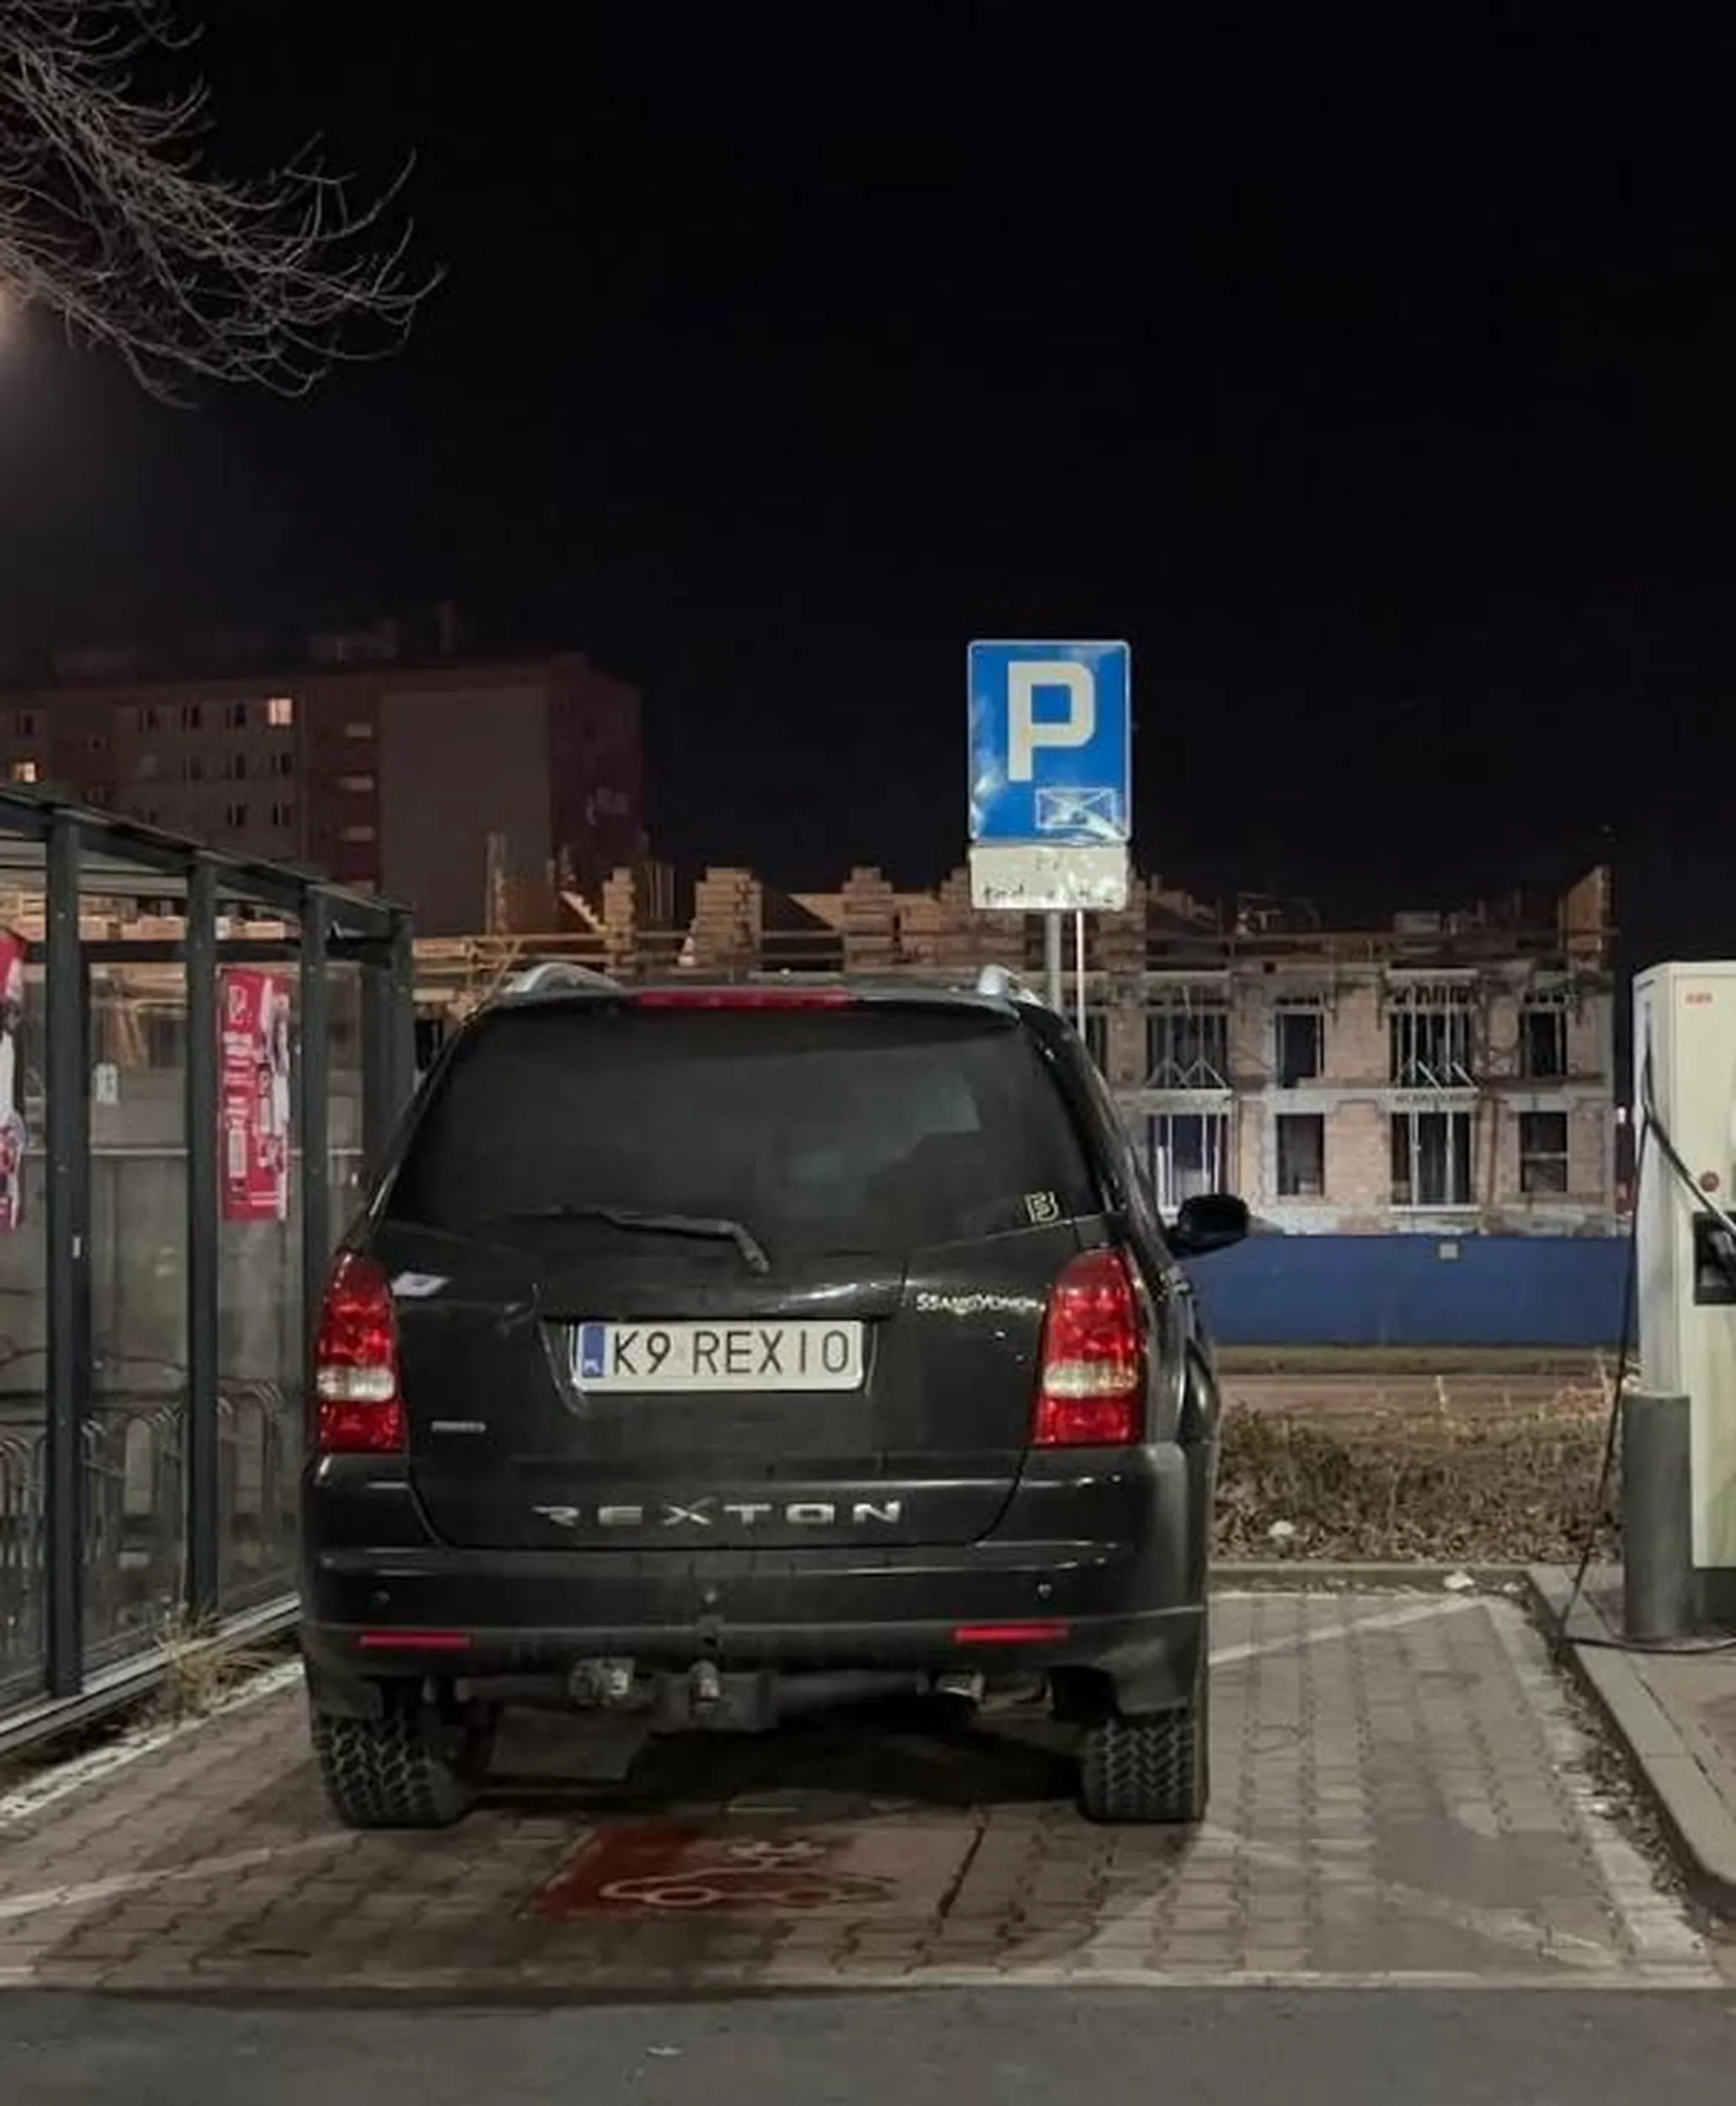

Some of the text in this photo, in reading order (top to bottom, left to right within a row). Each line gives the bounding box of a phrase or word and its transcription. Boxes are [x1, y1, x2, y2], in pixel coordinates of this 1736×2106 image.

[1008, 661, 1095, 782] P
[614, 1330, 671, 1375] K9
[532, 1496, 900, 1526] REXTON
